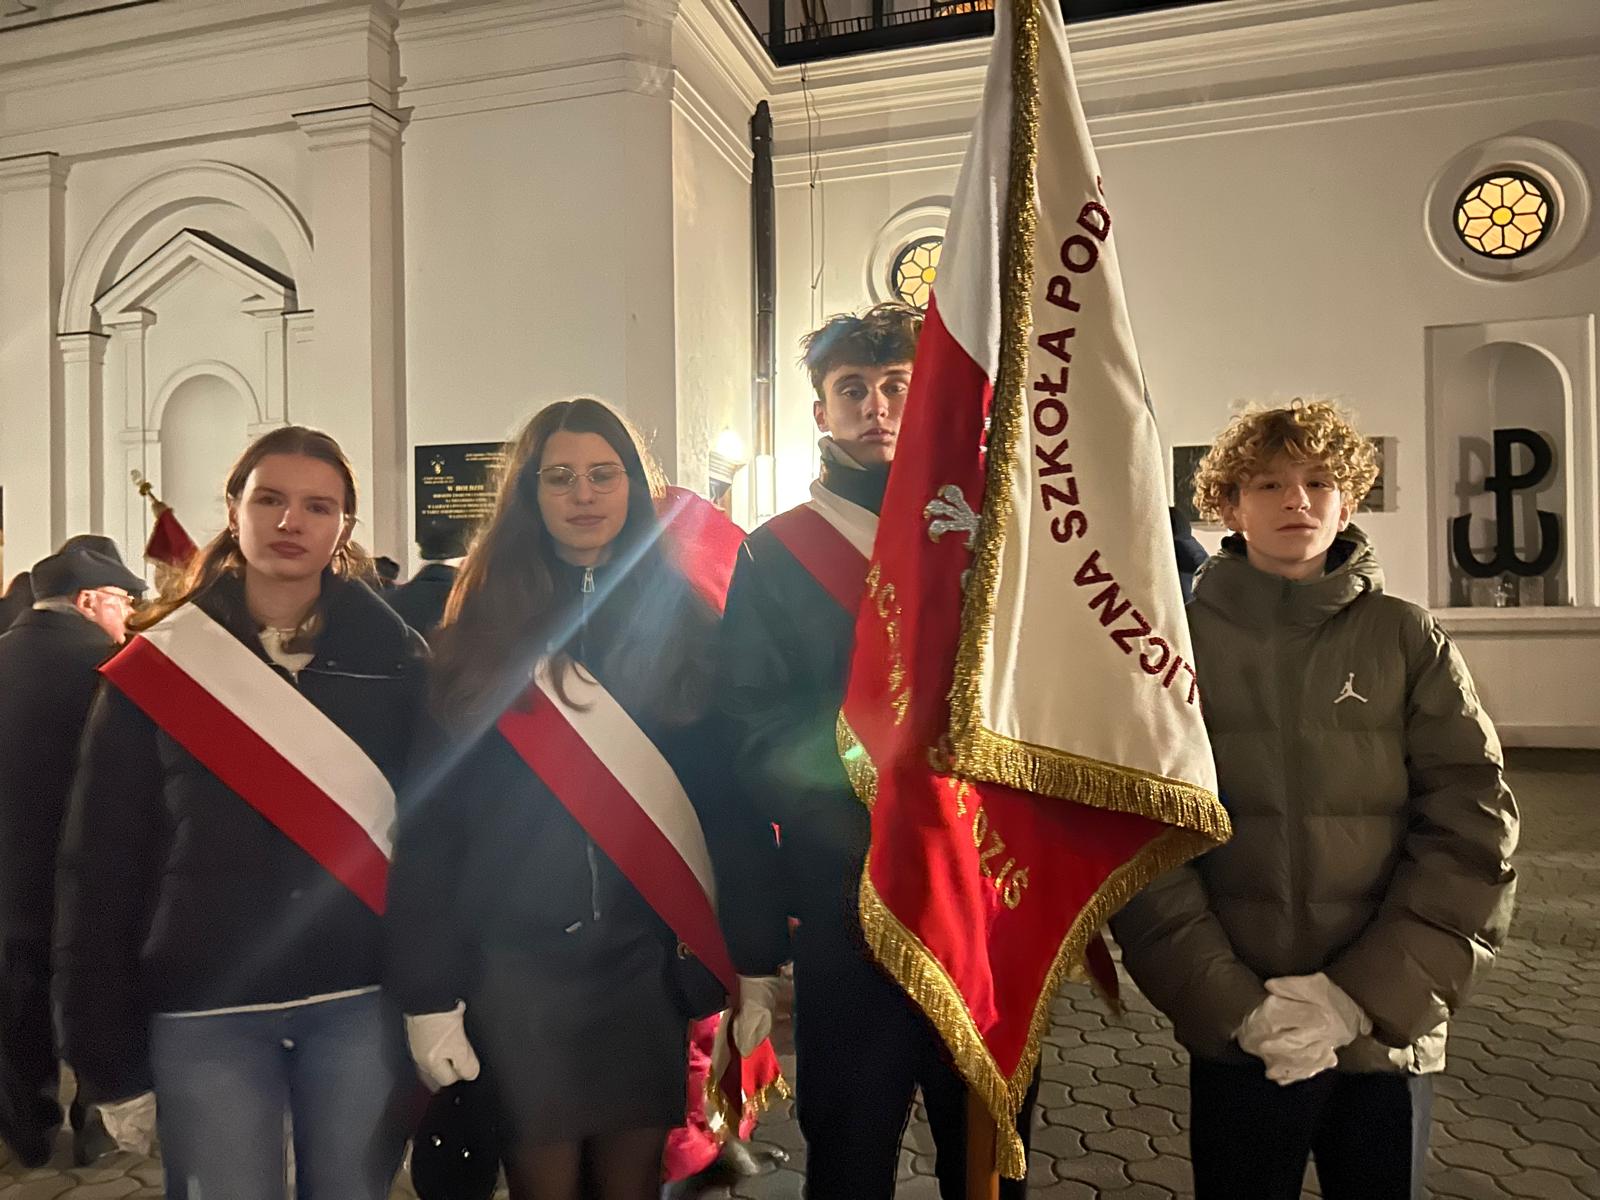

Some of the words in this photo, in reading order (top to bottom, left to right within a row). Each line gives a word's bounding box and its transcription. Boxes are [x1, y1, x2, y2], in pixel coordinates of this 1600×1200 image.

[1046, 174, 1111, 312] POD
[1034, 327, 1088, 543] SZKOŁA
[1074, 550, 1199, 706] LICZNA
